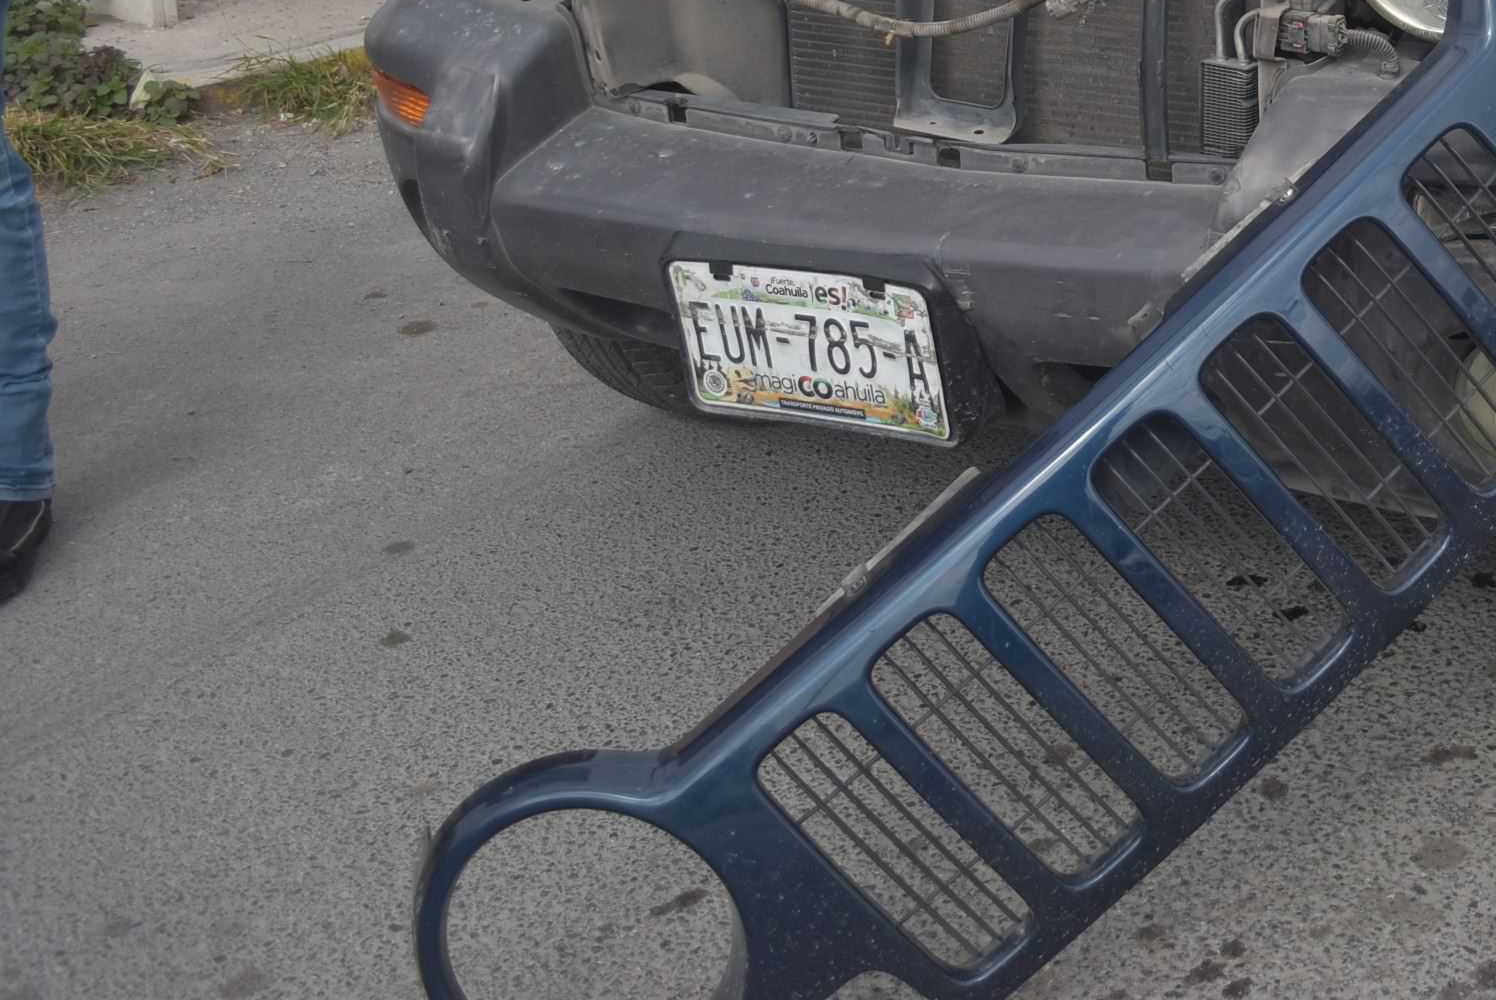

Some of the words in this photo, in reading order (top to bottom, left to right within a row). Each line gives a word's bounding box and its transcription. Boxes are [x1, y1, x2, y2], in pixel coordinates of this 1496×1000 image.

[766, 283, 809, 298] Coahuila
[815, 286, 847, 311] es!
[688, 300, 932, 405] EUM-785-A
